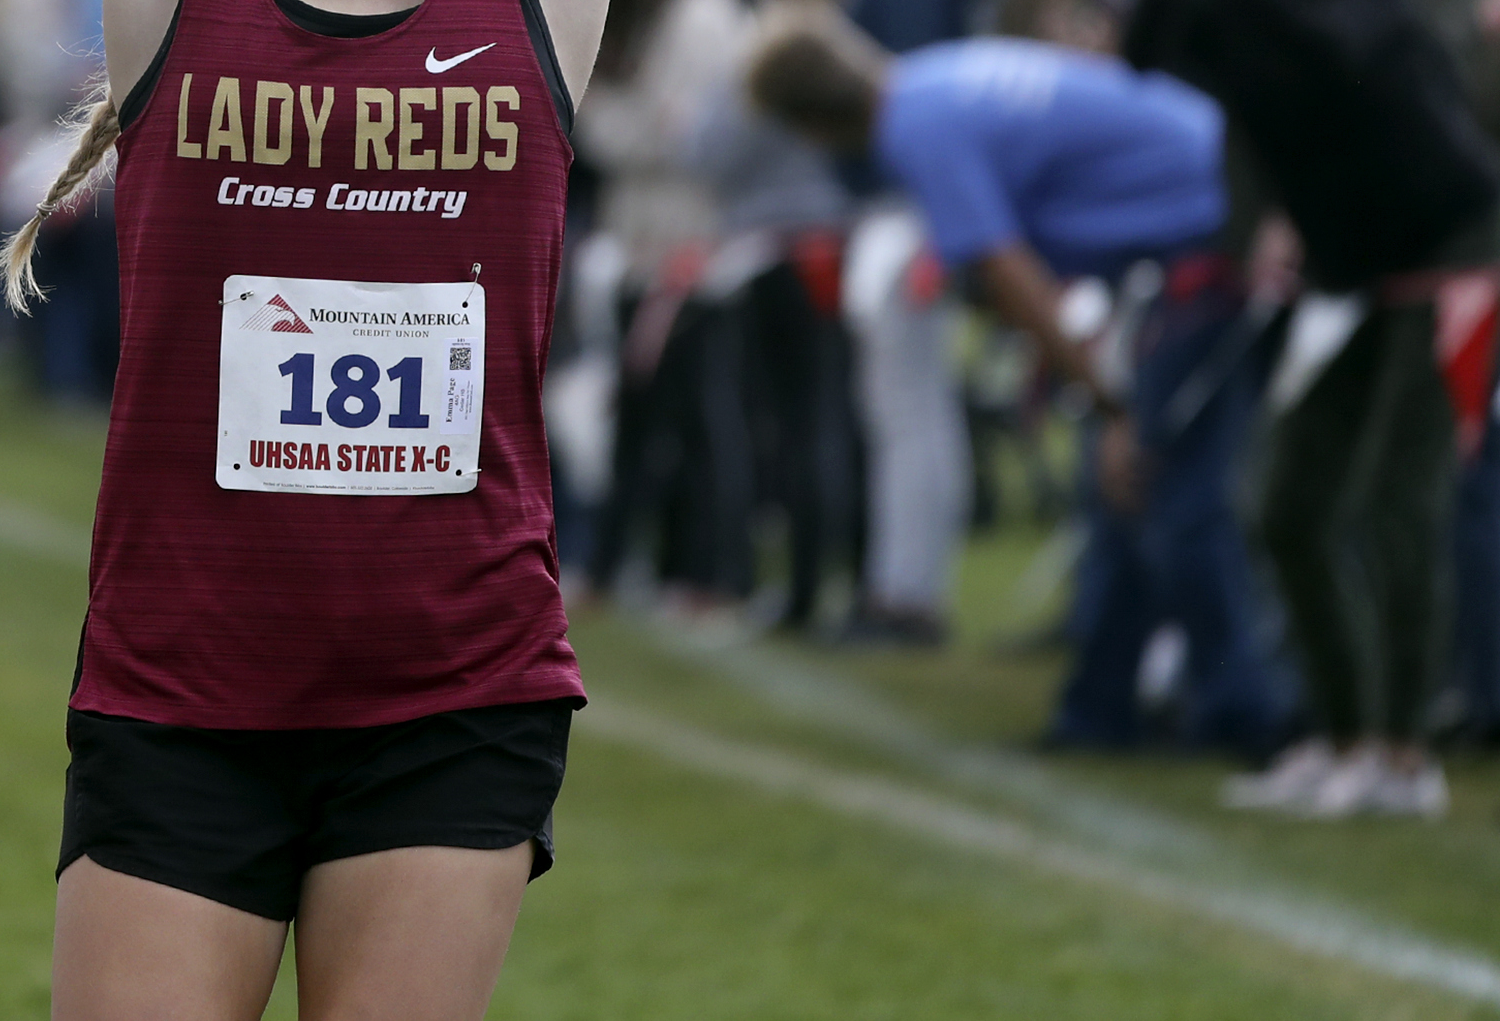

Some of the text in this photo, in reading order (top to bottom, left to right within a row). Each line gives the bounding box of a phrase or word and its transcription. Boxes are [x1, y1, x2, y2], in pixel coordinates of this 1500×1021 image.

[177, 73, 520, 171] LADY REDS
[216, 176, 468, 219] Cross Country
[309, 308, 471, 326] MOUNTAIN AMERICA
[352, 329, 430, 338] CREDIT UNION
[278, 352, 430, 429] 181
[445, 377, 456, 423] Emma Page
[250, 440, 451, 473] UHSAA STATE X-C
